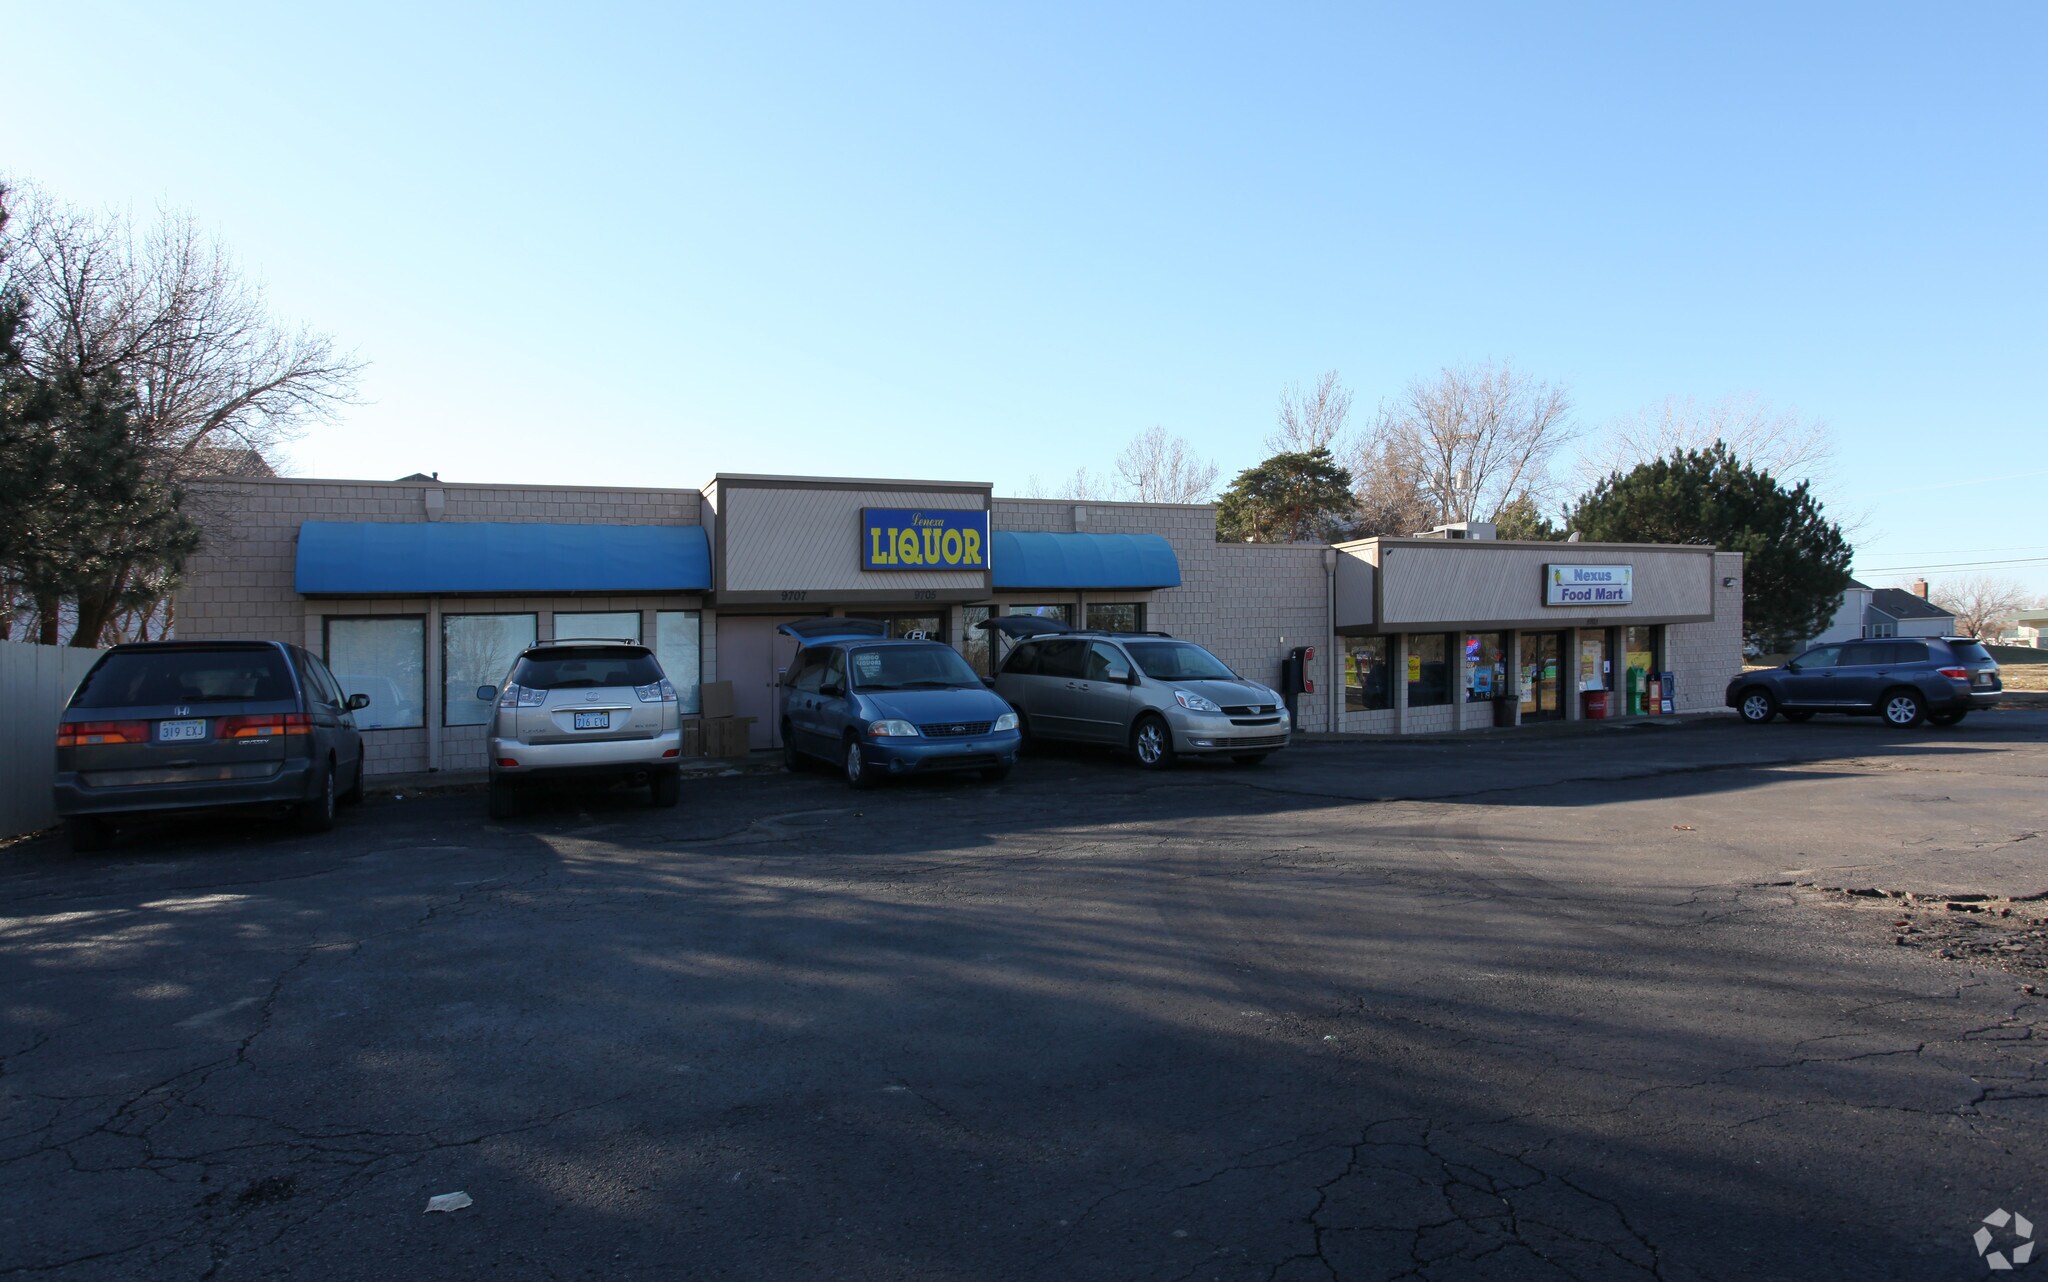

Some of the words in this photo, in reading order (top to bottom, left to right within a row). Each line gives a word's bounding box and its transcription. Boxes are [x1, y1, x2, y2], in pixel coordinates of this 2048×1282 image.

[911, 512, 945, 527] Lenexa
[870, 527, 982, 565] LIQUOR
[1573, 568, 1612, 582] Nexus
[781, 590, 807, 601] 9707
[914, 590, 937, 600] 9705
[1561, 588, 1592, 601] Food
[1595, 587, 1624, 600] Mart
[577, 718, 591, 727] 716
[594, 717, 608, 727] EYL
[162, 727, 181, 738] 319
[185, 726, 204, 737] EXJ
